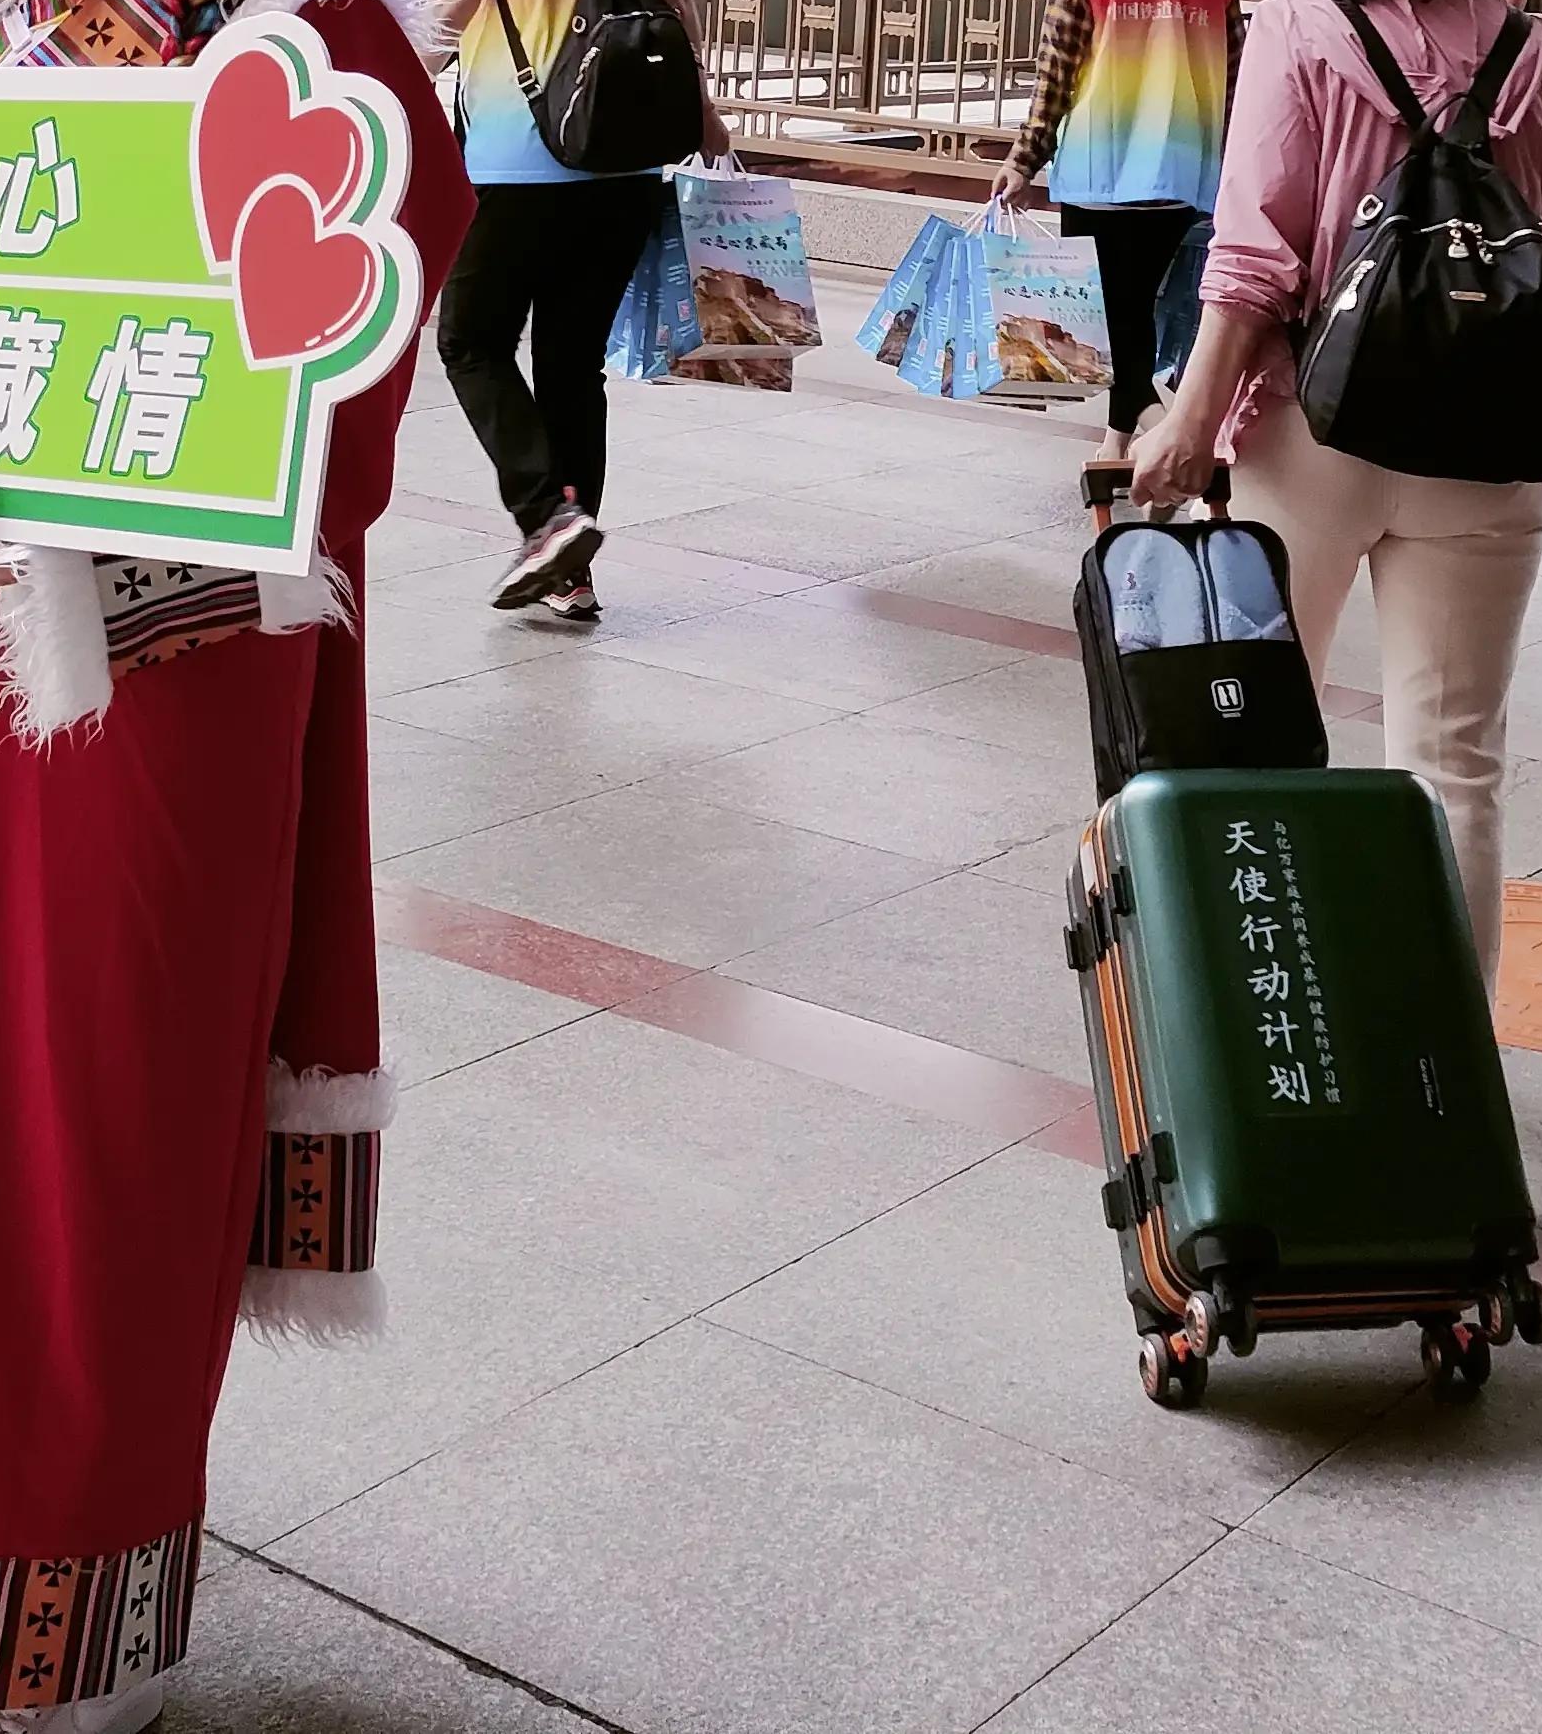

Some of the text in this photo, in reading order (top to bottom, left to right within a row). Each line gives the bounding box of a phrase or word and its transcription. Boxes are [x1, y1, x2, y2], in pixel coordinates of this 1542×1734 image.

[1223, 820, 1311, 1105] 天使行动计划
